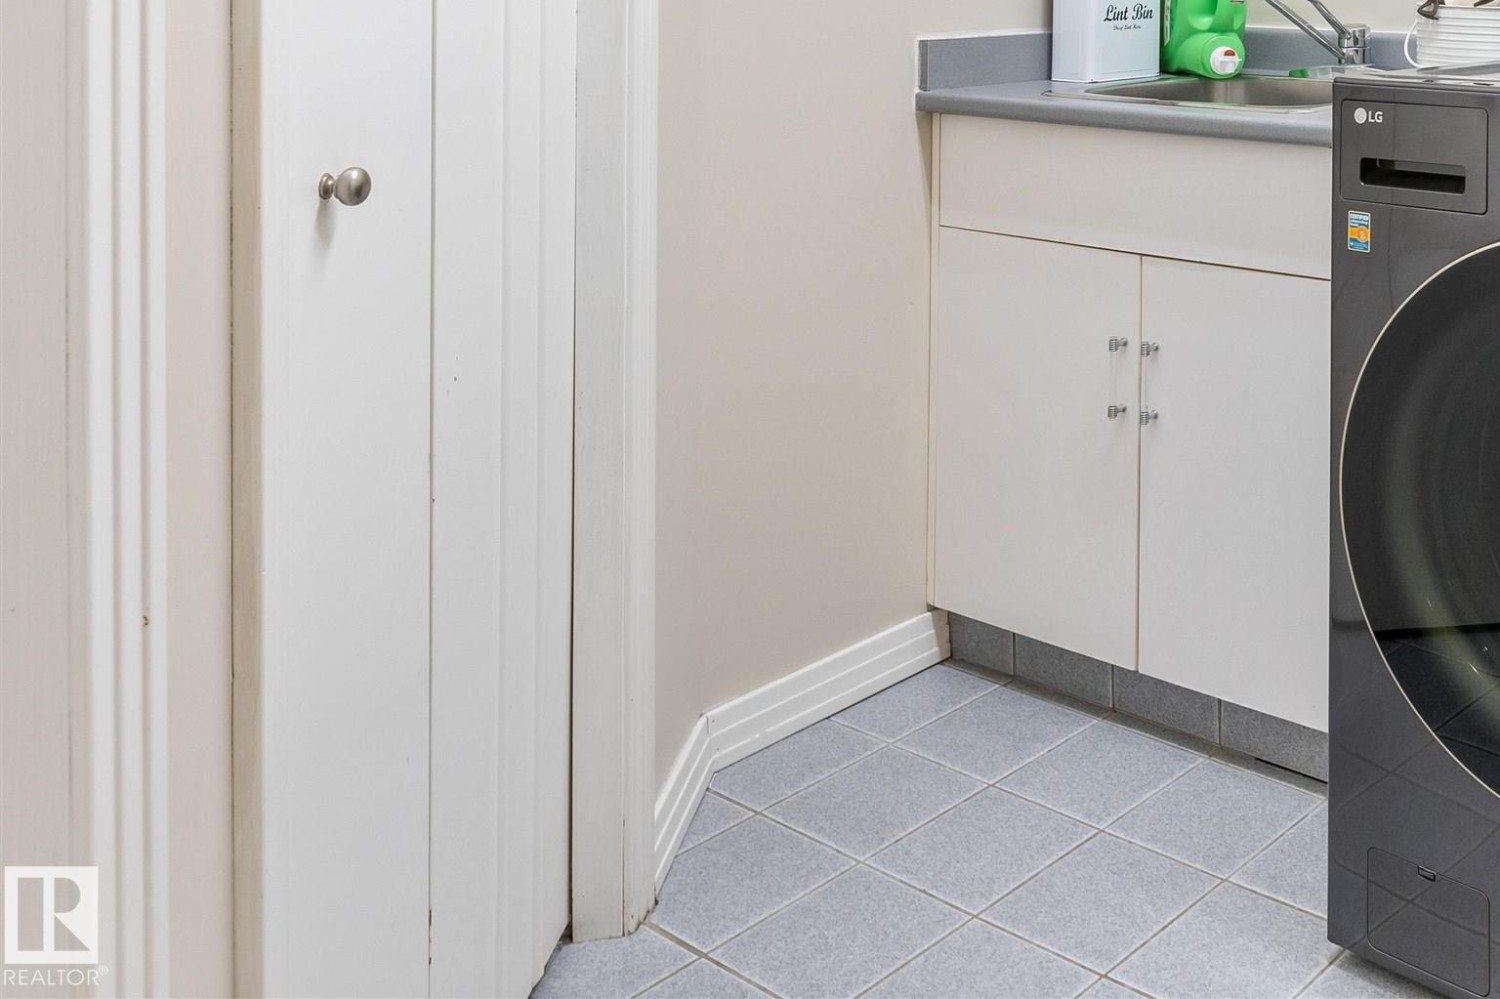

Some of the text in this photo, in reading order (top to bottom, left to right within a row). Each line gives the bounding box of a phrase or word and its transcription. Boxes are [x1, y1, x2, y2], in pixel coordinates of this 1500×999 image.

[1103, 3, 1154, 22] Lint Bin
[1368, 110, 1384, 123] LG
